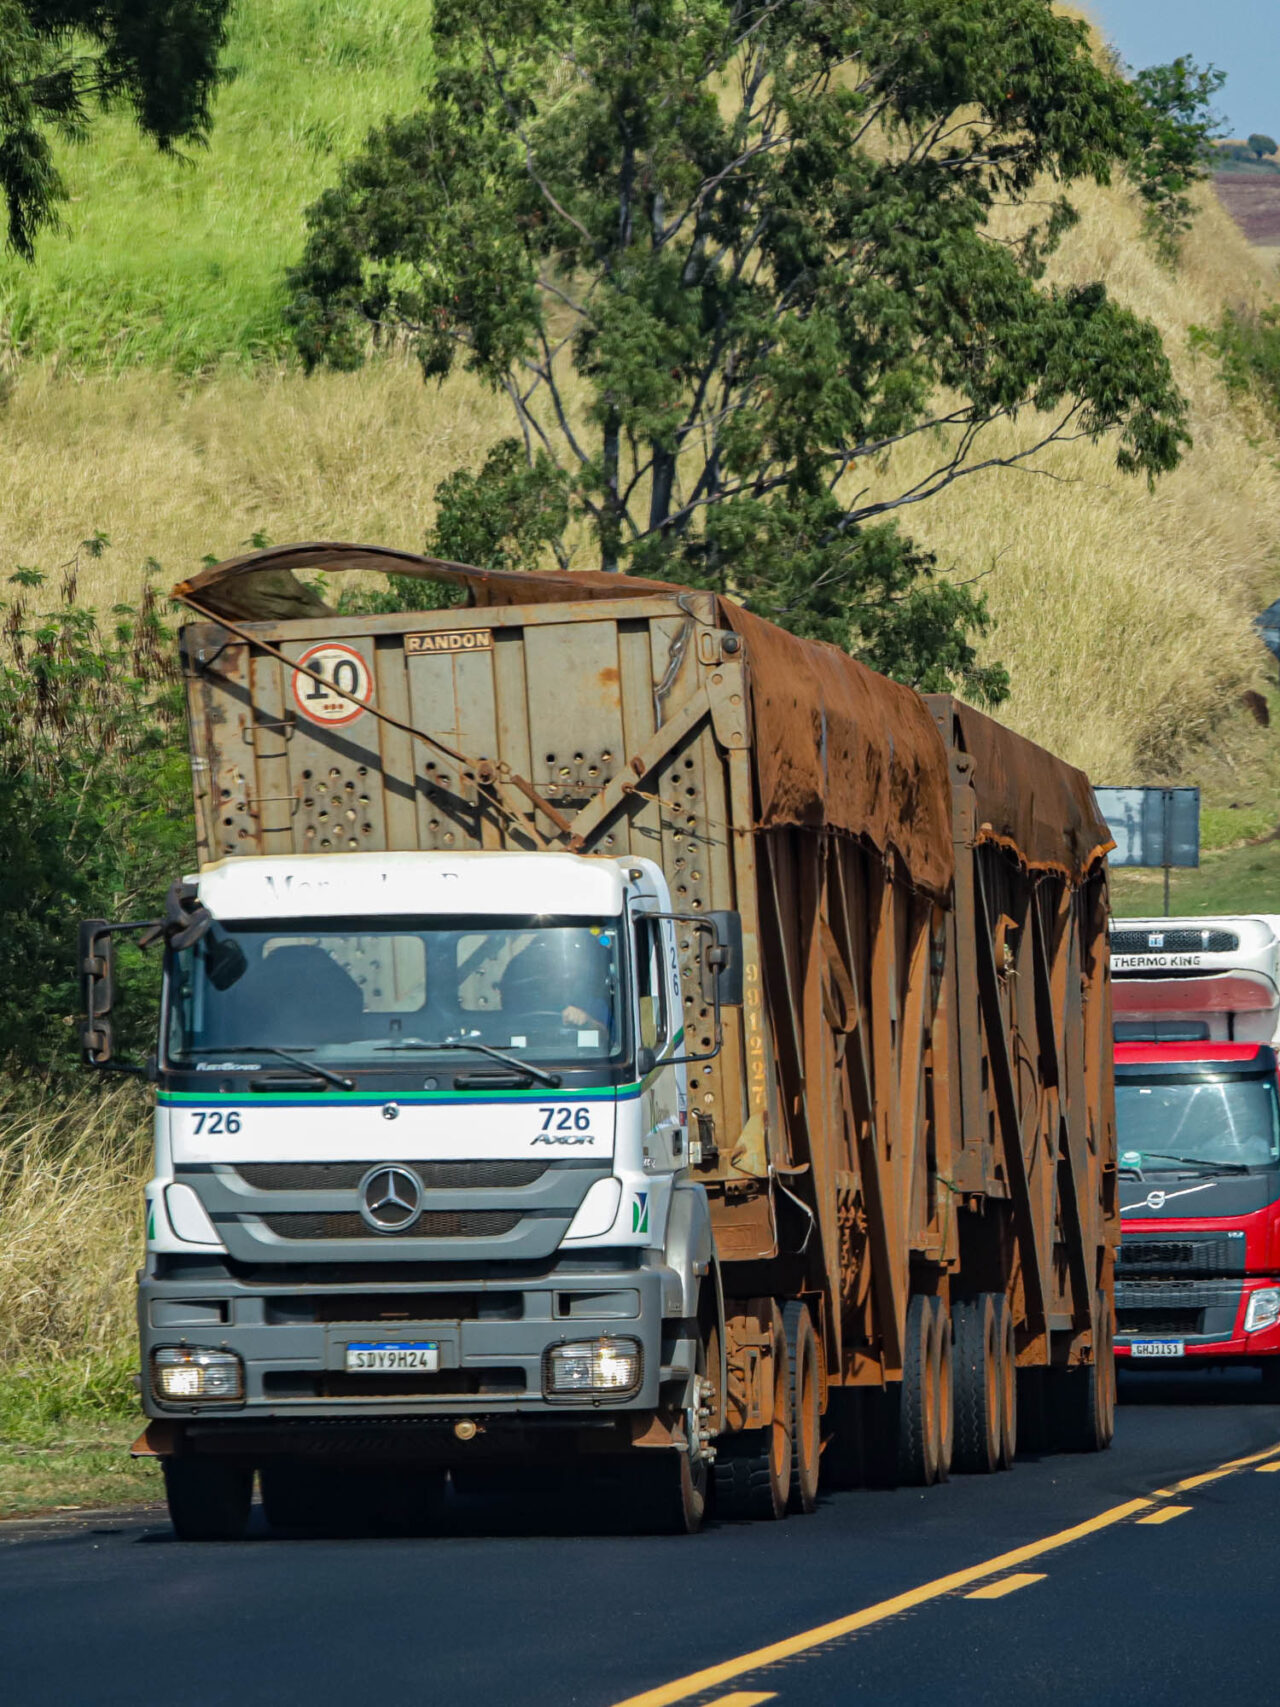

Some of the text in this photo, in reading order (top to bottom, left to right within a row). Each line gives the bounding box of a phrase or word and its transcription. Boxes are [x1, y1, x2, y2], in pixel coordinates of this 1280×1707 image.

[408, 633, 491, 651] RANDON
[306, 659, 359, 700] 10
[667, 919, 680, 996] 726
[1113, 956, 1201, 968] THERMO KING
[191, 1111, 241, 1135] 726
[539, 1107, 590, 1131] 726
[530, 1133, 596, 1146] AXOR
[356, 1351, 428, 1368] SDY9H24
